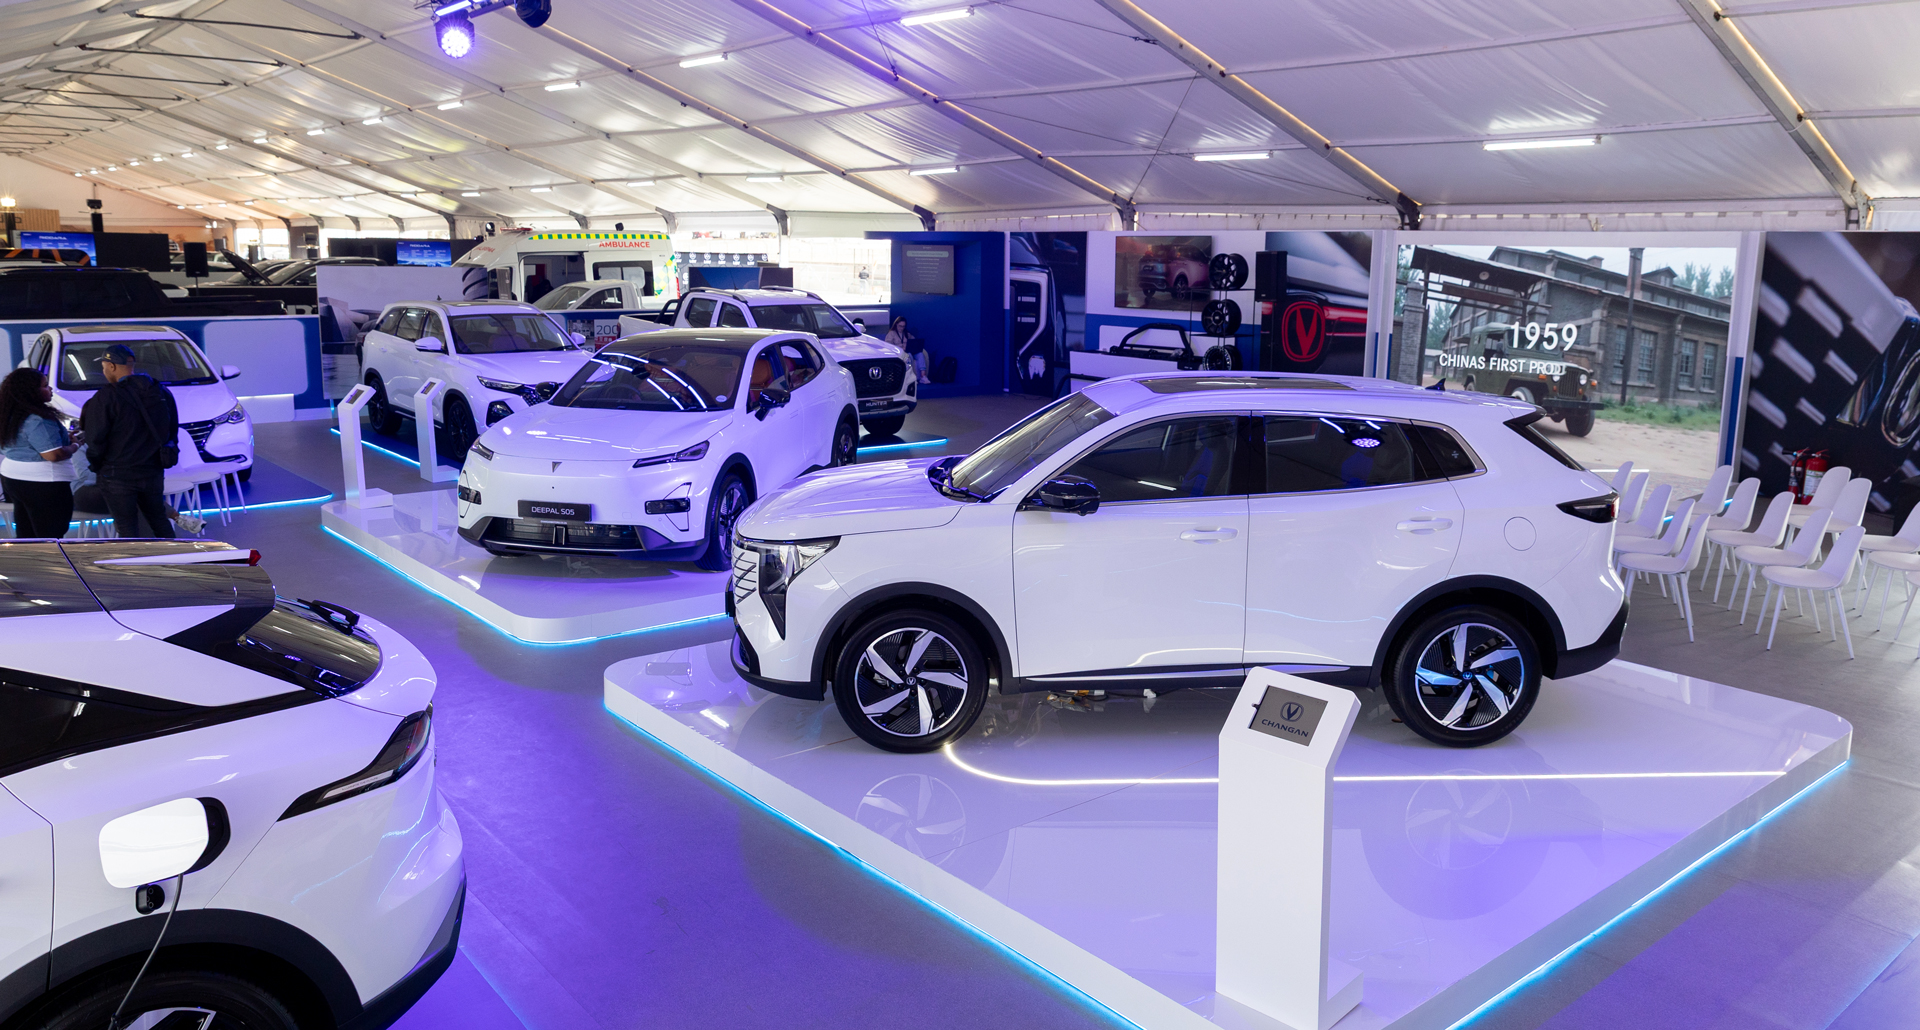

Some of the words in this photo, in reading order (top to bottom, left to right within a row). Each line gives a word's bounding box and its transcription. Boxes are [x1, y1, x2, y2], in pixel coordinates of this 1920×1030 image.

[1510, 321, 1578, 351] 1959
[1439, 353, 1486, 370] CHINAS
[1489, 357, 1526, 373] FIRST
[531, 506, 560, 515] DEEPAL
[1261, 718, 1309, 738] CHANGAN
